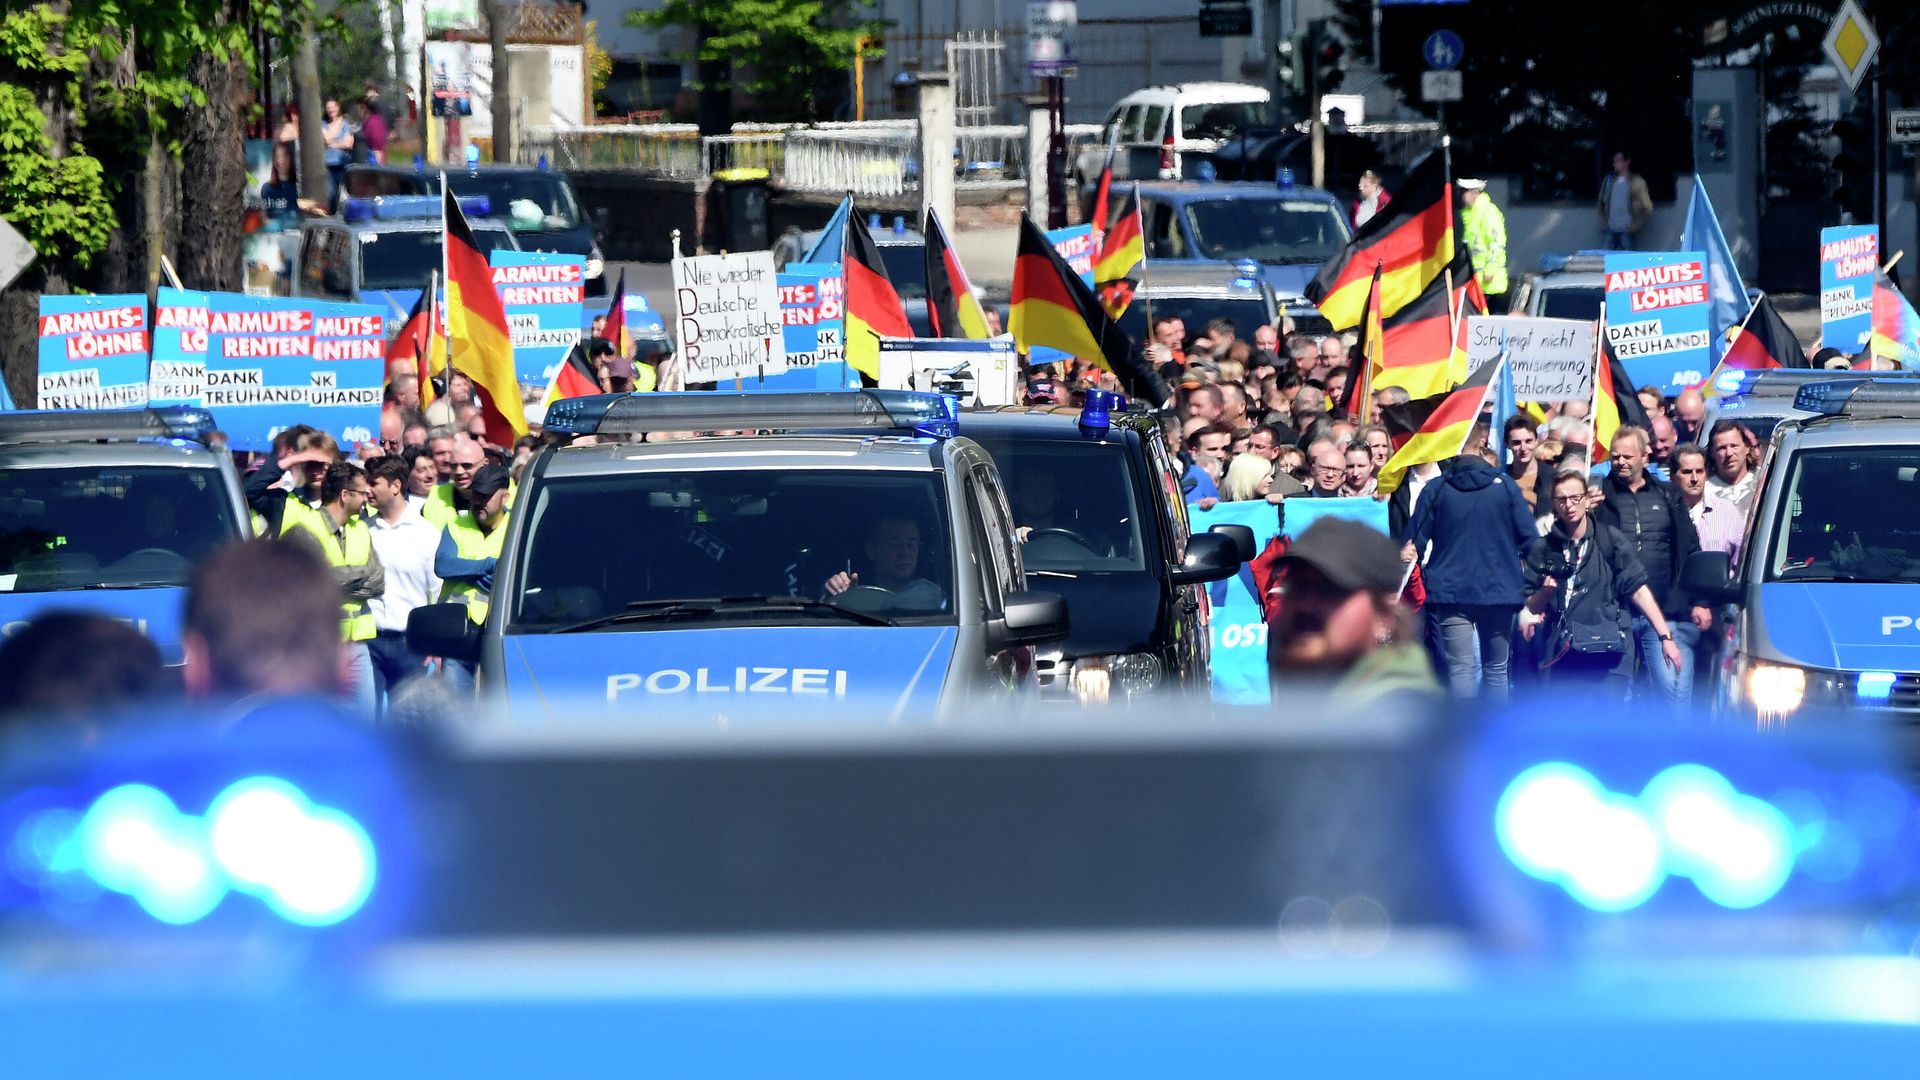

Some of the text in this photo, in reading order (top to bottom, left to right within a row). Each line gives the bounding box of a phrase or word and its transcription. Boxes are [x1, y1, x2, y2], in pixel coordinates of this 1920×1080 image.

[492, 265, 579, 284] ARMUTS-
[683, 258, 765, 286] Nie wieder
[1608, 263, 1702, 291] ARMUTS-
[503, 286, 579, 304] RENTEN
[678, 285, 757, 317] Deutsche
[1631, 285, 1705, 312] LÖHNE
[43, 308, 141, 336] ARMUTS-
[210, 310, 312, 333] ARMUTS-
[682, 311, 781, 345] Demokratische
[1610, 323, 1659, 341] DANK
[67, 331, 143, 359] LÖHNE
[223, 336, 309, 357] RENTEN
[1540, 328, 1576, 348] nicht
[1511, 359, 1585, 375] amisierung
[43, 370, 96, 391] DANK
[207, 372, 258, 386] DANK
[205, 390, 309, 404] TREUHAND!
[311, 391, 380, 405] UHAND!
[606, 666, 847, 700] POLIZEI
